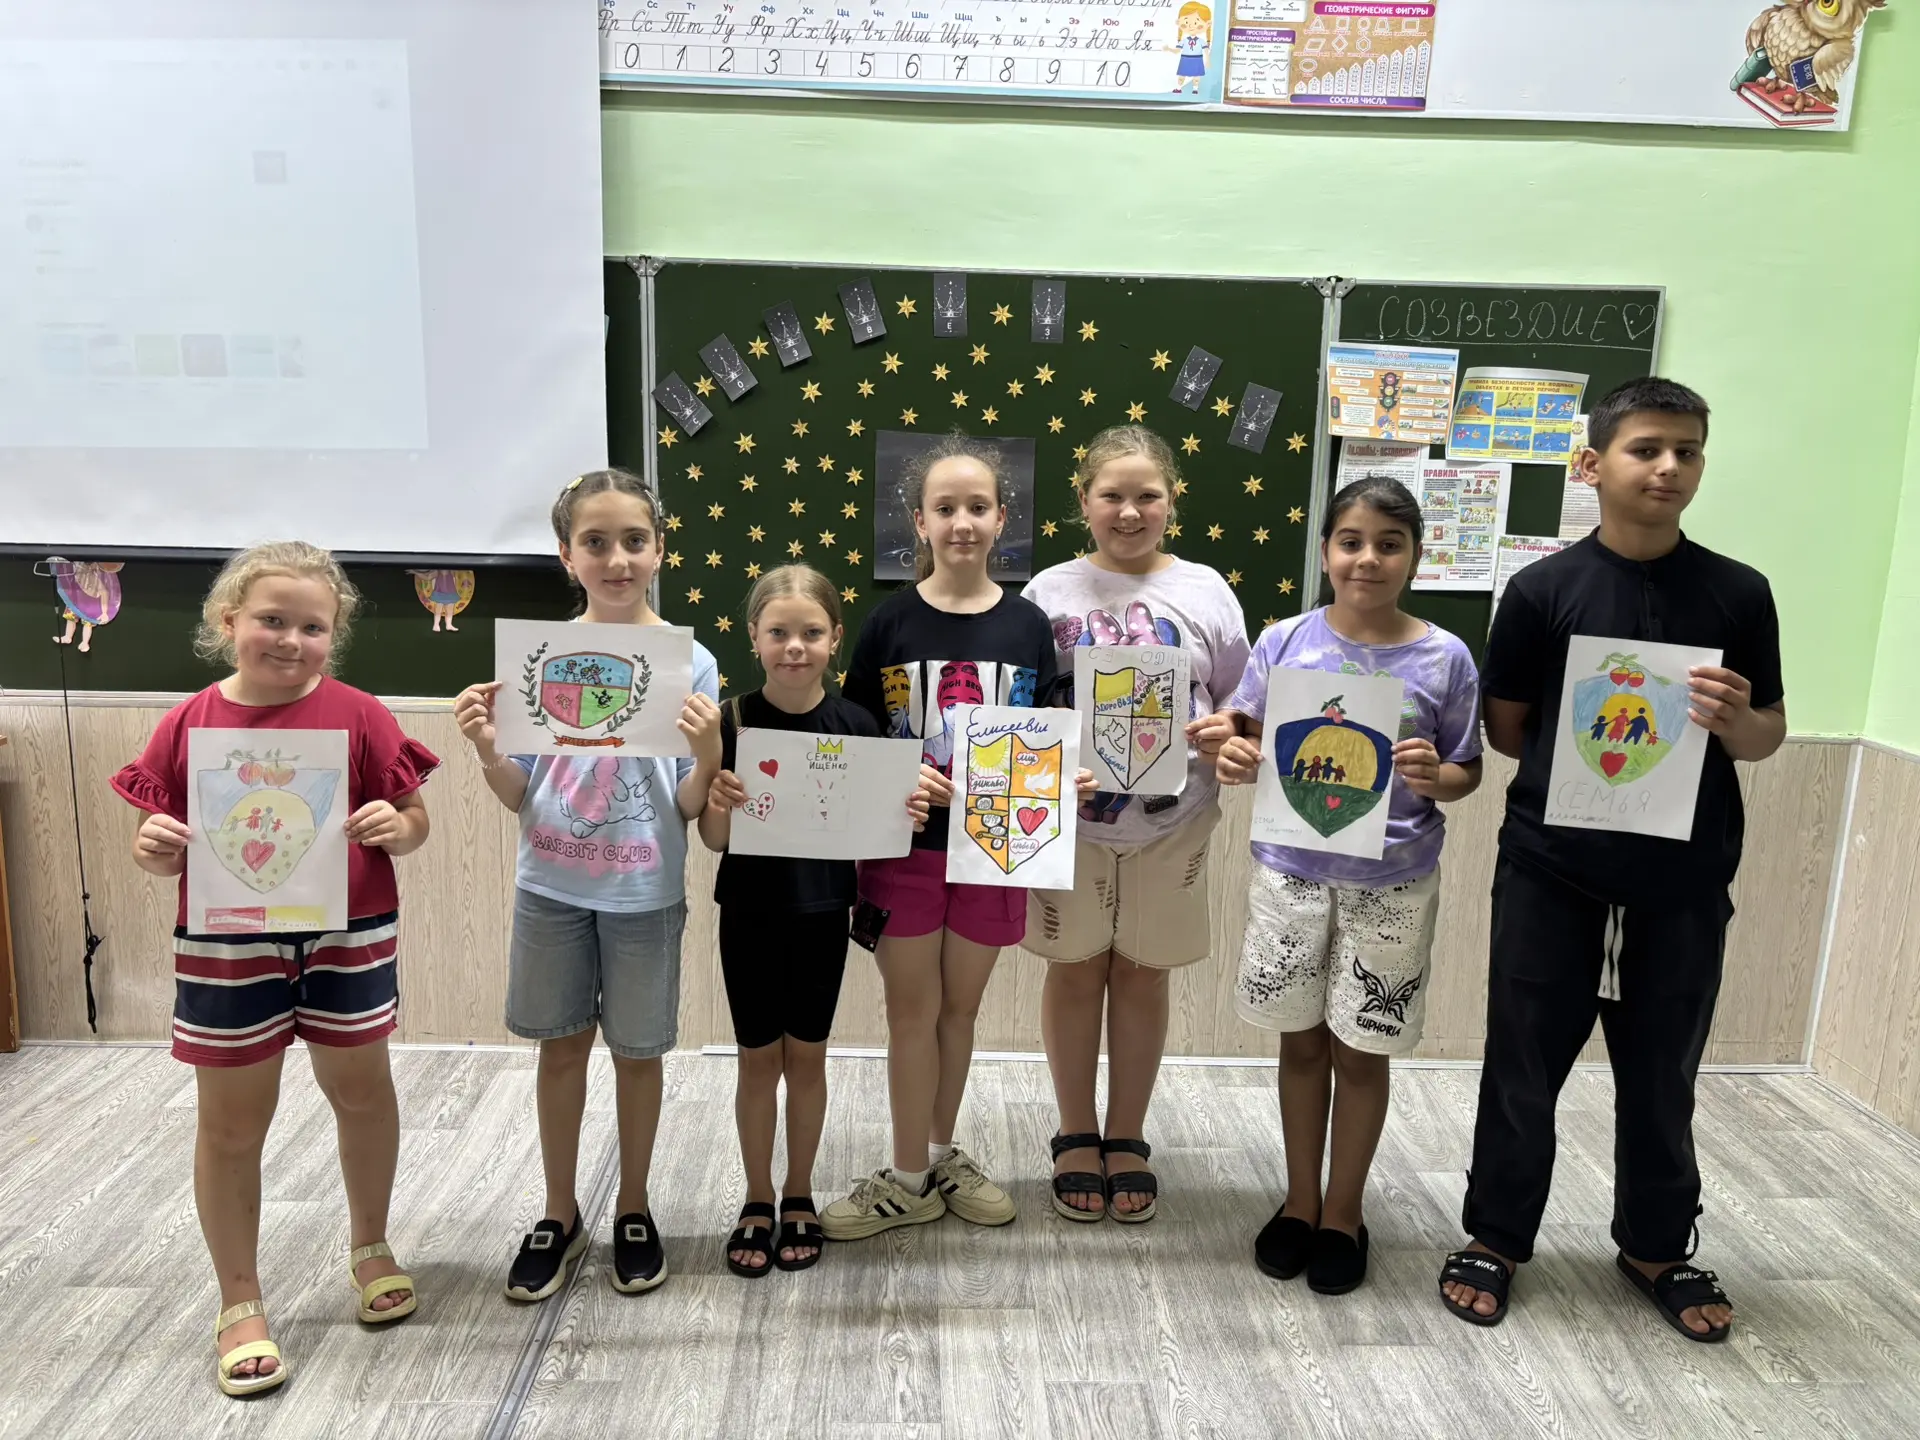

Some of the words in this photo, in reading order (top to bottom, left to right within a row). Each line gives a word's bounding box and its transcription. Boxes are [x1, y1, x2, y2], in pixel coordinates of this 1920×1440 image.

[687, 2, 696, 10] Тт
[723, 3, 733, 13] Уу
[760, 5, 775, 15] Фф
[802, 7, 814, 15] Хх
[837, 8, 850, 17] Цц
[873, 9, 884, 17] Чч
[912, 11, 929, 19] Шш
[955, 13, 972, 22] Щщ
[1069, 17, 1080, 25] Ээ
[1103, 18, 1119, 26] Юю
[1324, 5, 1393, 15] ГЕОМЕТРИЧЕСКИЕ
[1395, 6, 1429, 15] ФИГУРЫ
[624, 43, 639, 68] 0
[676, 45, 687, 70] 1
[718, 47, 734, 72] 2
[764, 49, 780, 74] 3
[816, 51, 828, 76] 4
[858, 52, 874, 77] 5
[906, 54, 921, 78] 6
[954, 55, 968, 80] 7
[1000, 57, 1014, 83] 8
[1046, 59, 1061, 84] 9
[1096, 61, 1130, 87] 10
[1329, 96, 1359, 104] СОСТАВ
[1360, 97, 1387, 105] ЧИСЛА
[1379, 296, 1617, 341] СОЗВЕЗДИЕ
[1423, 469, 1458, 477] ПРАВИЛА
[806, 752, 838, 761] СЕМЬЯ
[809, 762, 848, 771] ИЩЕНКО
[1557, 780, 1651, 814] СЕМЬЯ
[532, 831, 598, 860] RABBIT
[603, 845, 651, 862] CLUB
[1356, 1015, 1401, 1037] EUPHORIA
[1474, 1259, 1498, 1272] NIKE
[1673, 1272, 1693, 1281] NIKE
